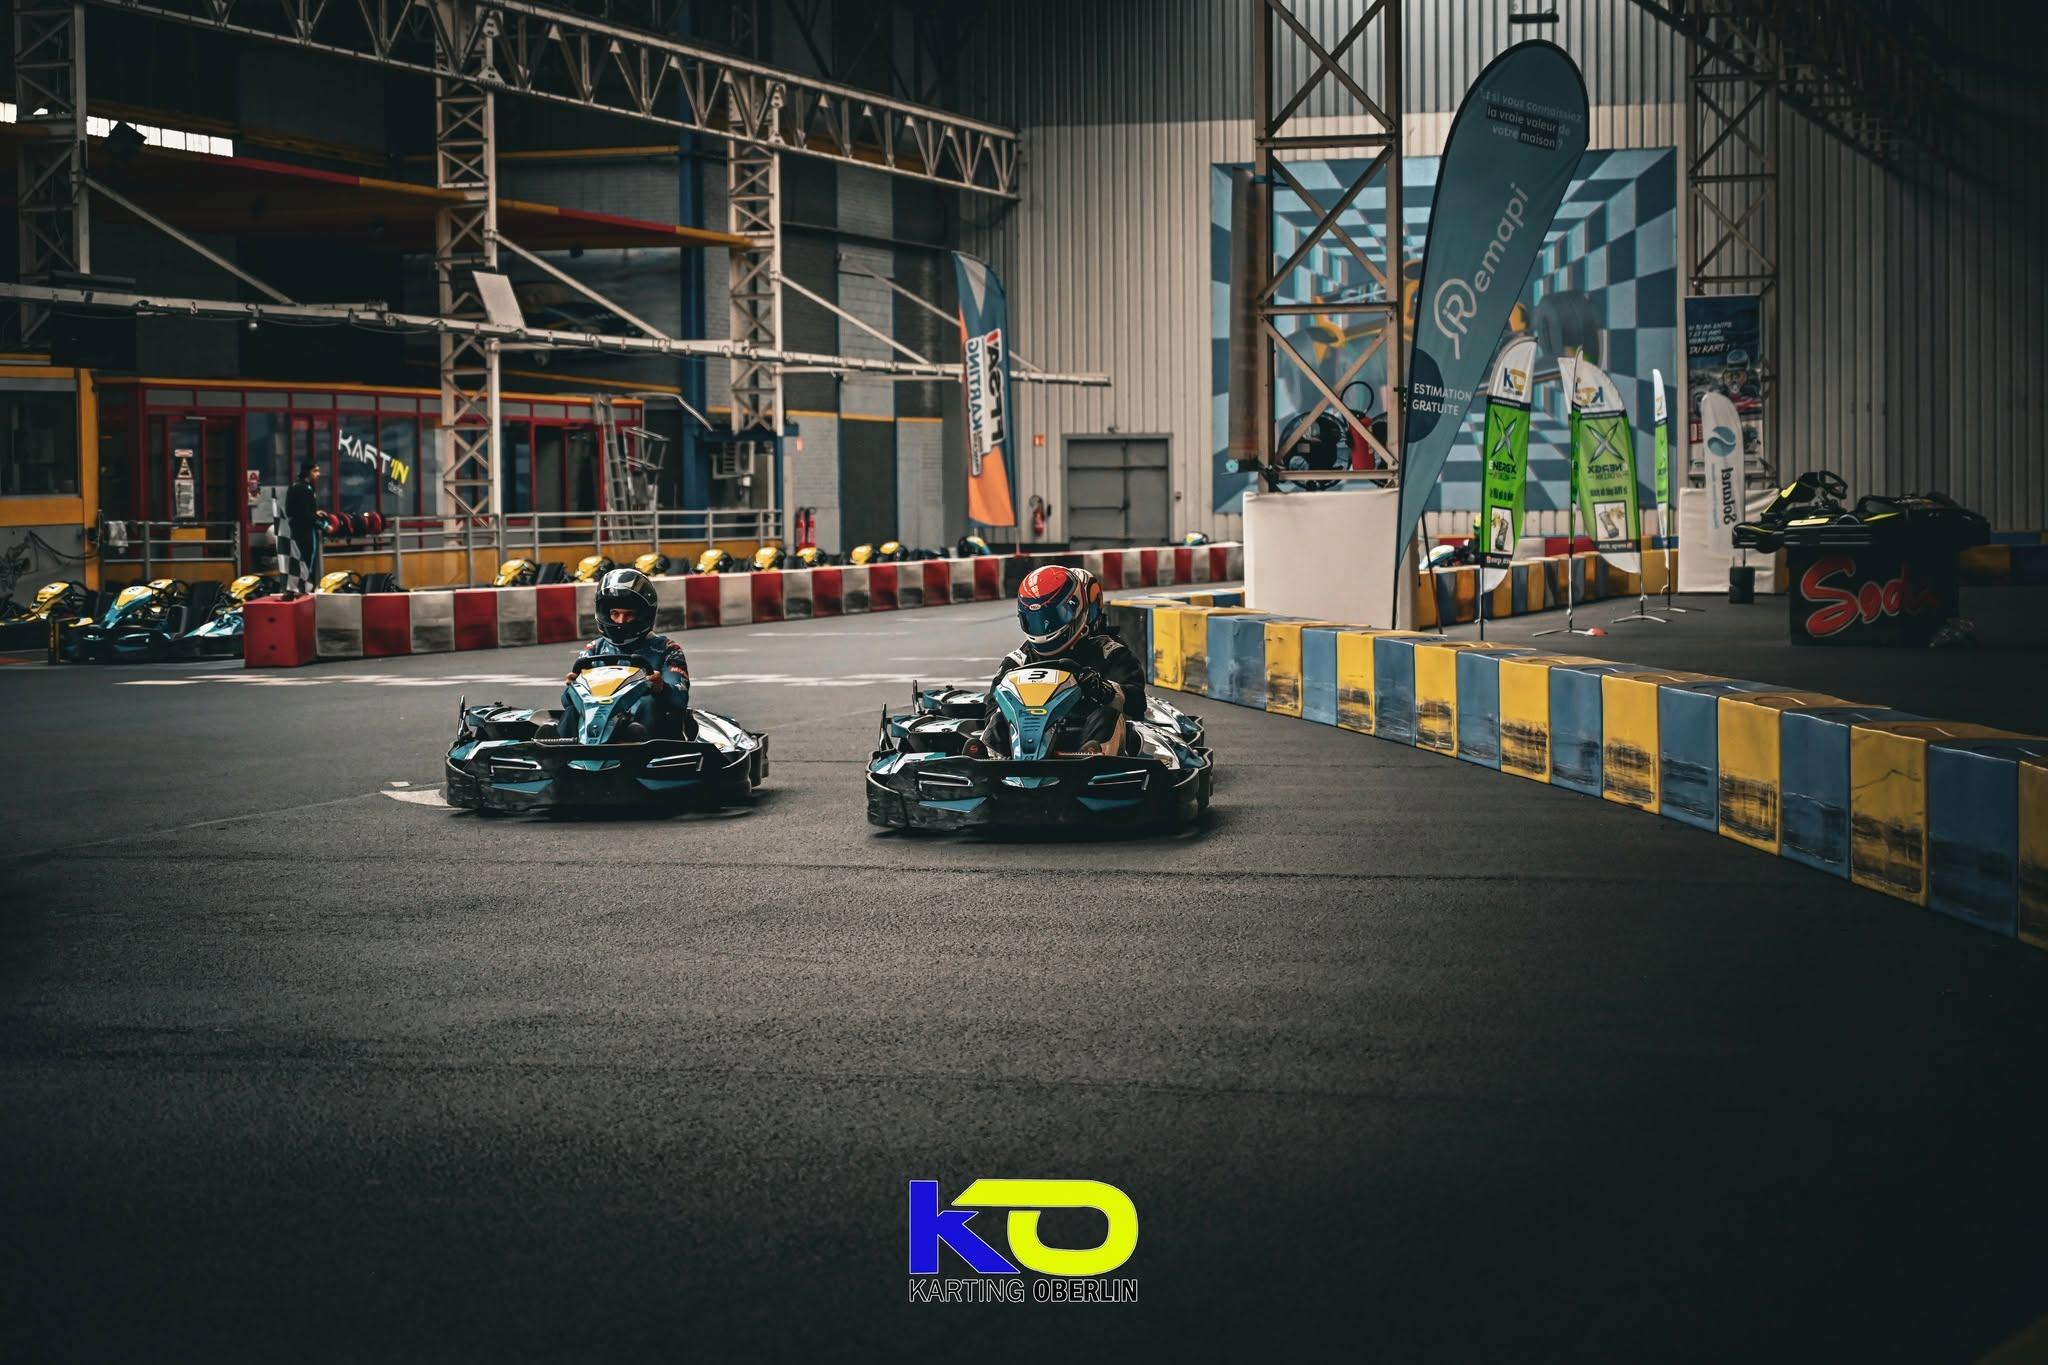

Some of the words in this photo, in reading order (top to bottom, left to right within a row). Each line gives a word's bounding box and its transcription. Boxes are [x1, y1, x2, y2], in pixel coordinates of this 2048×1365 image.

[1491, 91, 1500, 103] si
[1502, 95, 1525, 108] vous
[1487, 105, 1498, 118] la
[1500, 110, 1525, 125] vraie
[1526, 117, 1557, 132] valeur
[1558, 124, 1571, 137] de
[1492, 126, 1520, 140] votre
[1520, 132, 1556, 147] maison
[1413, 383, 1472, 401] ESTIMATION
[1412, 399, 1459, 416] GRATUITE
[1028, 670, 1049, 681] 3
